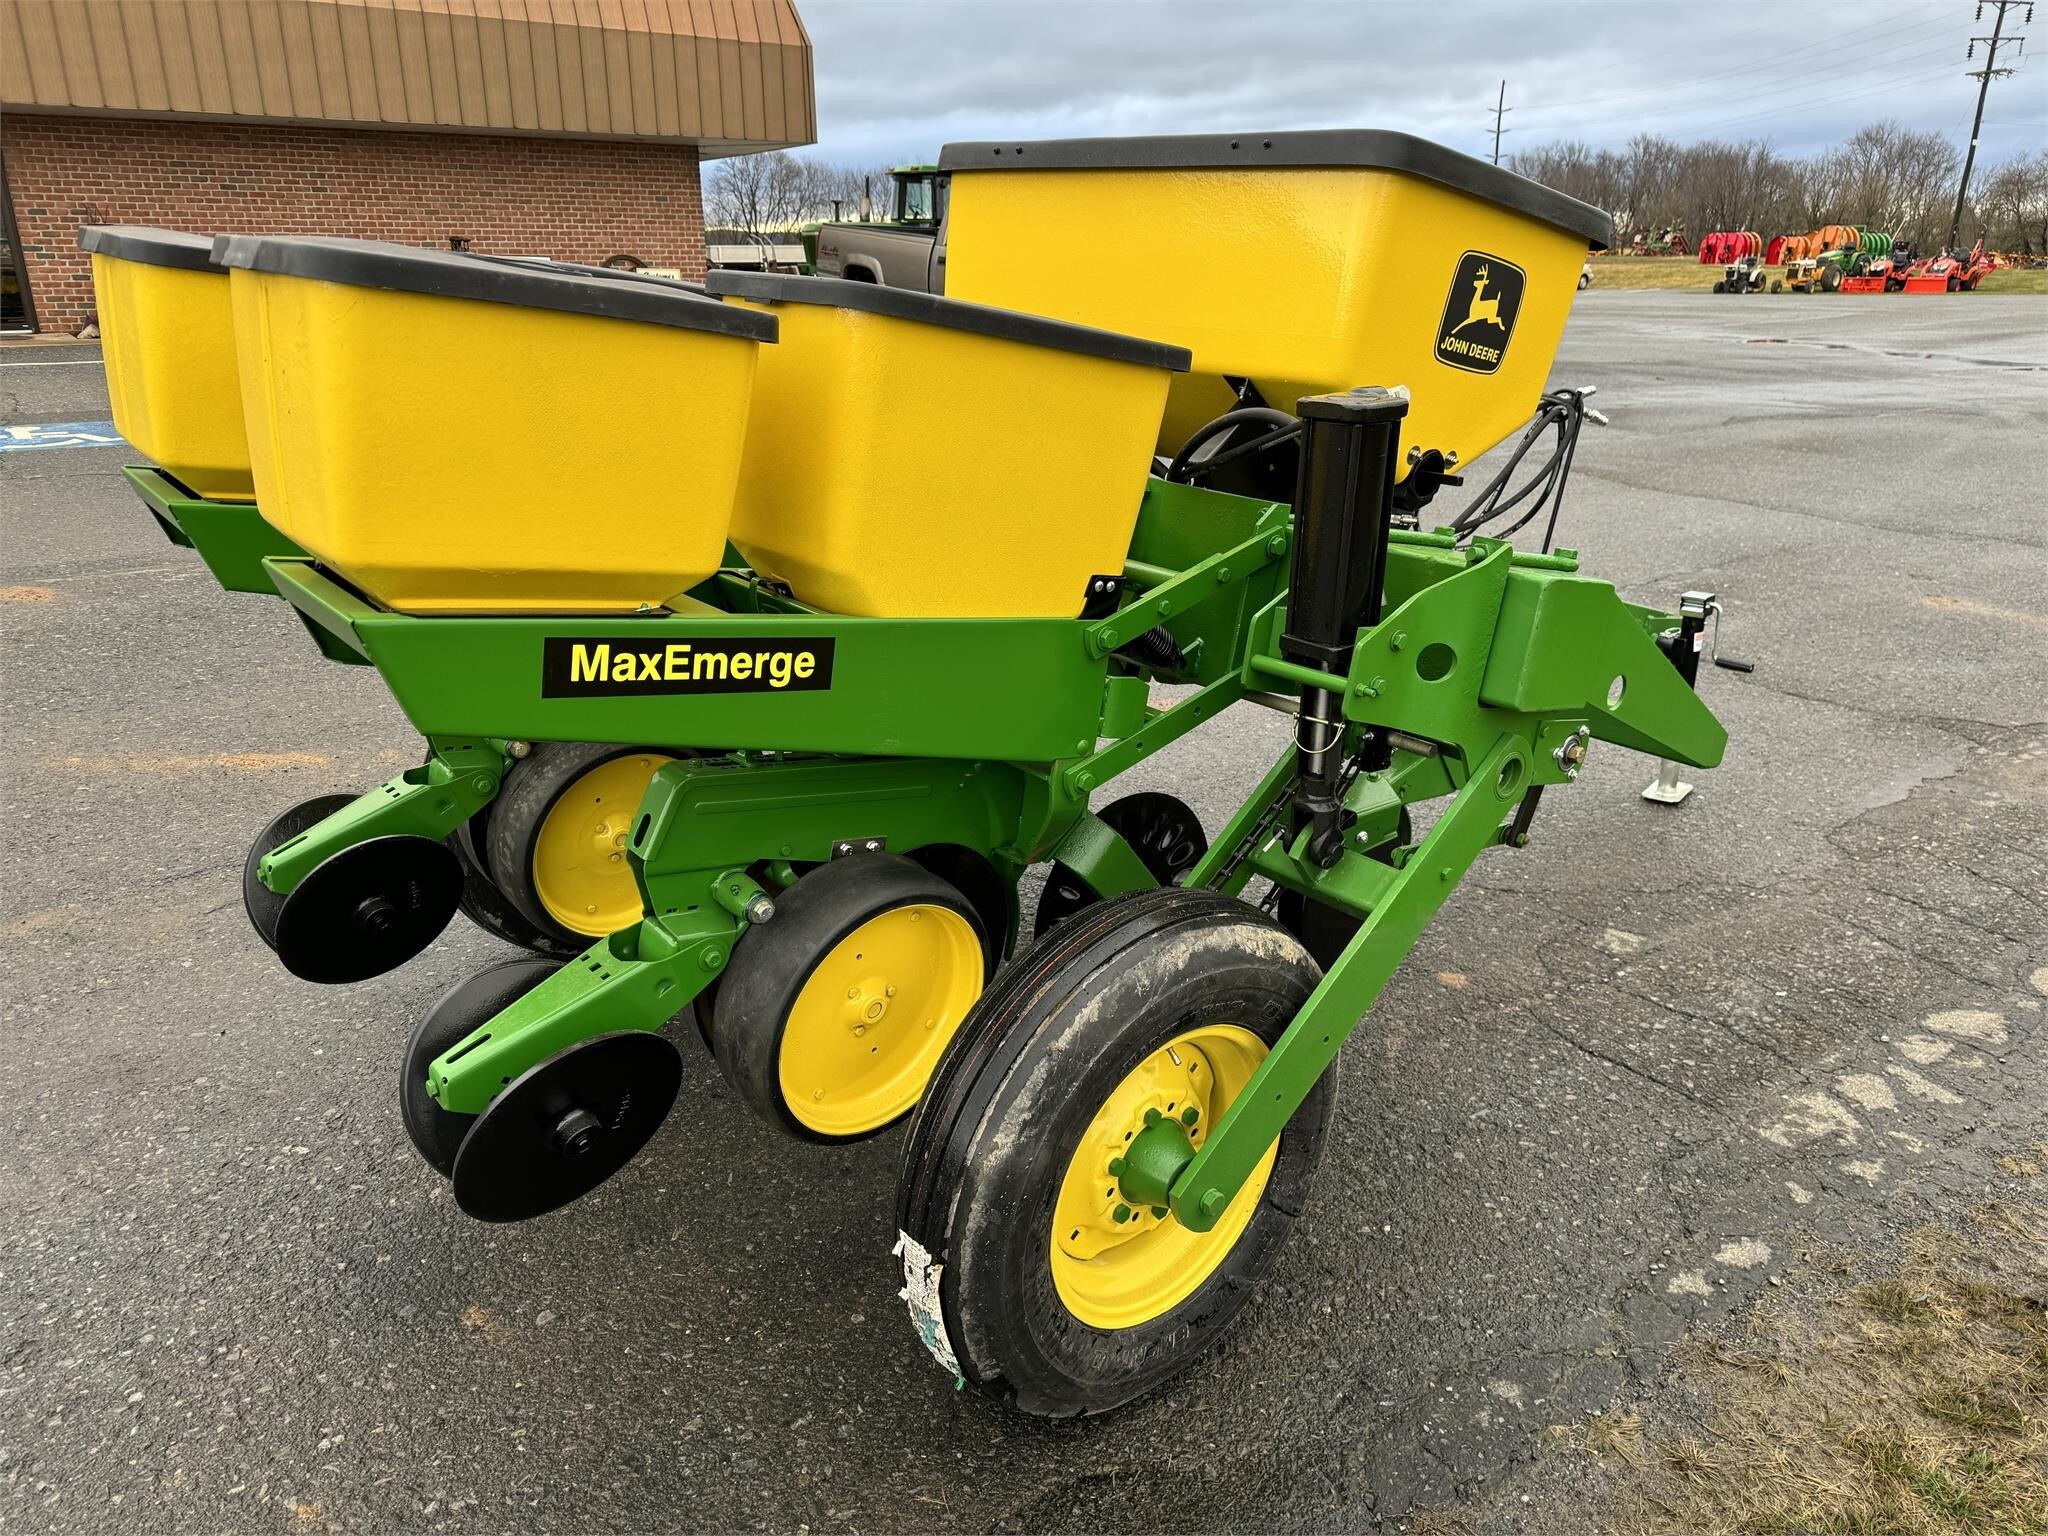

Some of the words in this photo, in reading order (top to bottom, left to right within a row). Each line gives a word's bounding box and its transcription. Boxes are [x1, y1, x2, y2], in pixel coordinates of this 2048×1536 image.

[1441, 336, 1469, 355] JOHN
[1469, 343, 1500, 363] DEERE
[570, 644, 816, 688] MaxEmerge
